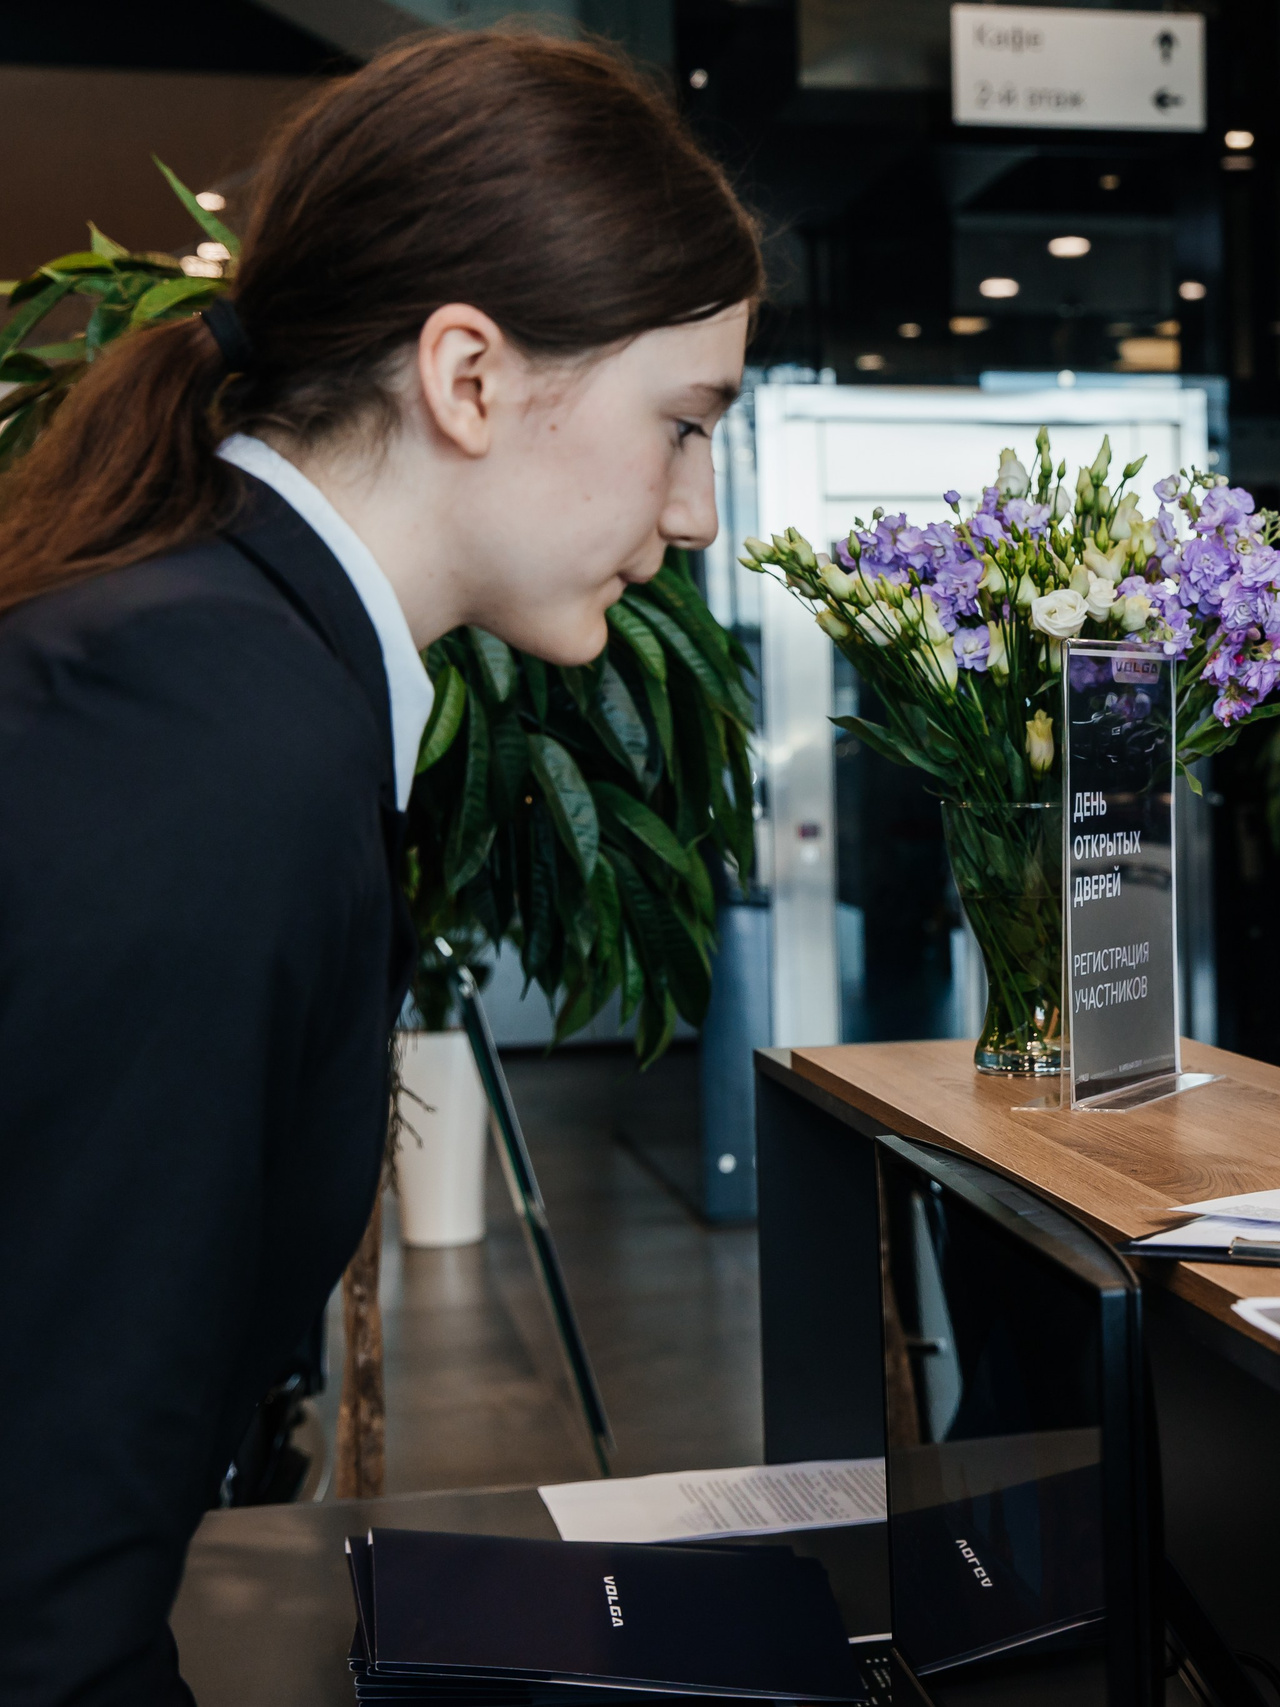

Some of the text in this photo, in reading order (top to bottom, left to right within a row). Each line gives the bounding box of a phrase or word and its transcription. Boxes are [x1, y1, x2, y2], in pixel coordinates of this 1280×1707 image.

[1115, 661, 1159, 674] VOLGA
[1073, 791, 1107, 823] ДЕНЬ
[1074, 830, 1142, 860] ОТКРЫТЫХ
[1073, 865, 1121, 908] ДВЕРЕЙ
[1074, 941, 1149, 977] РЕГИСТРАЦИЯ
[1074, 975, 1148, 1014] УЧАСТНИКОВ
[603, 1575, 624, 1627] VOLGA
